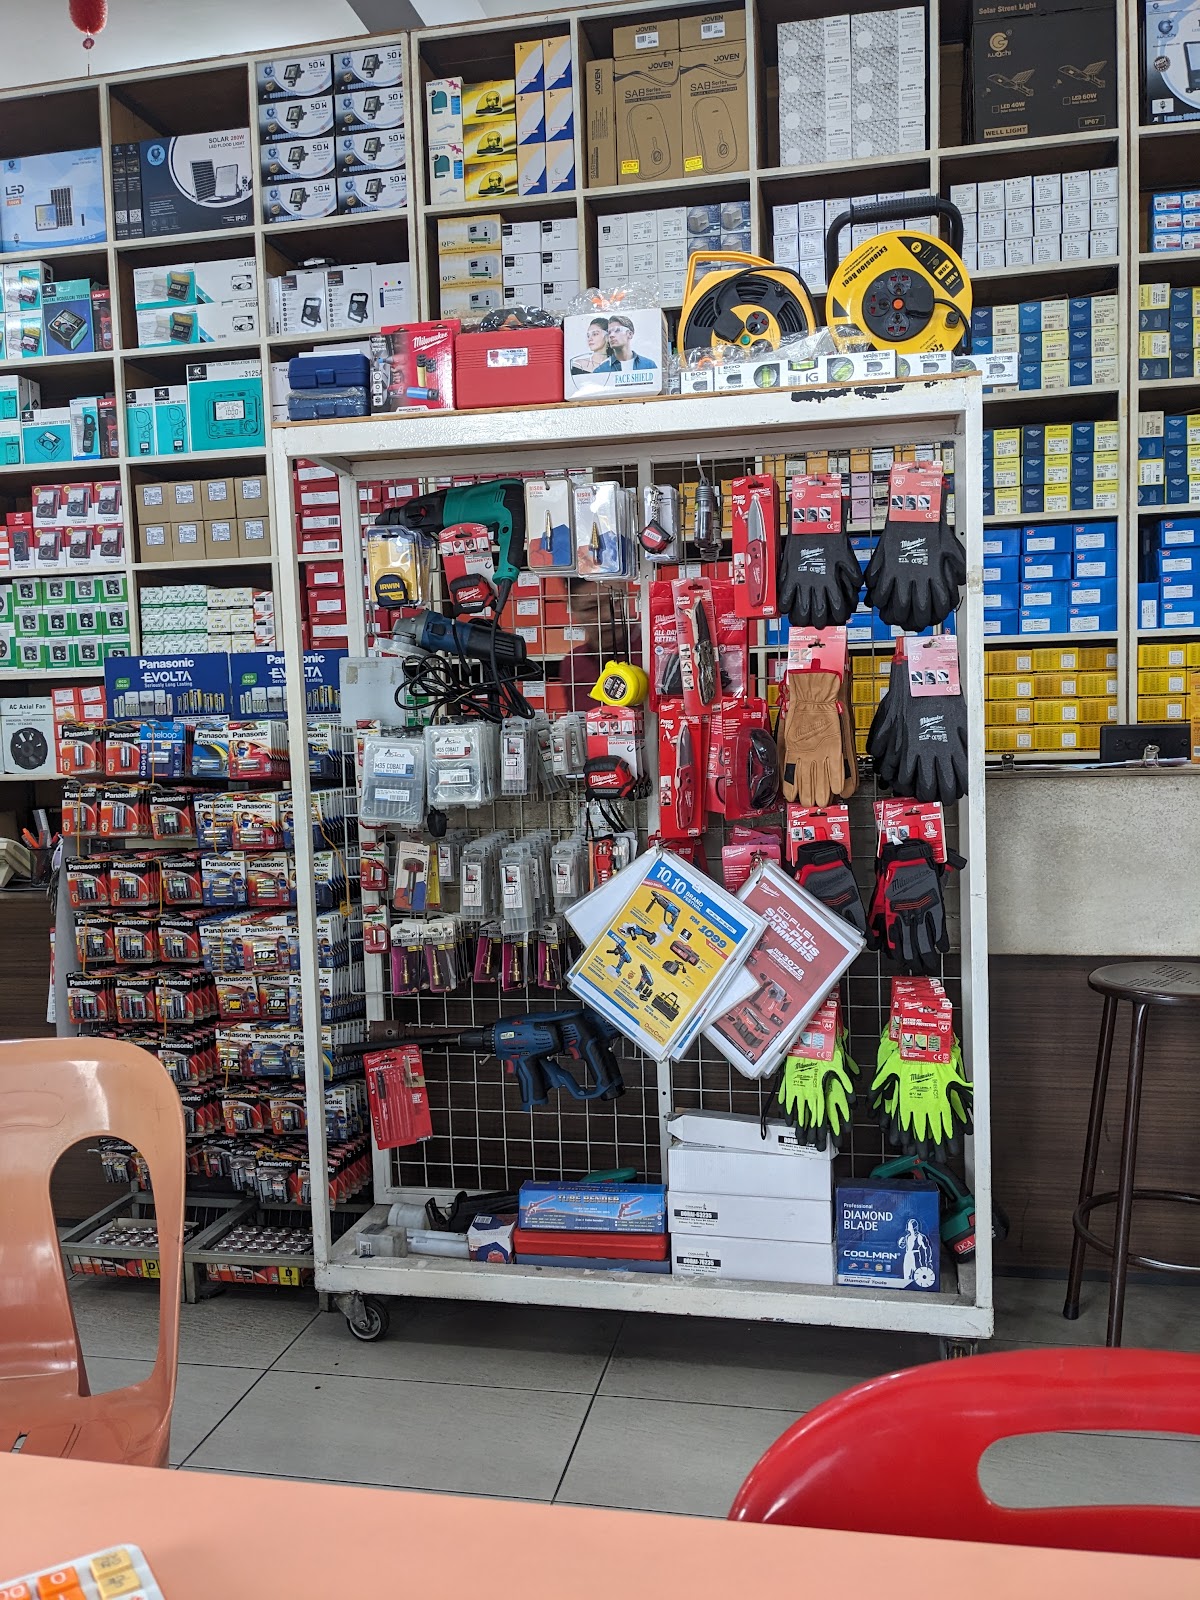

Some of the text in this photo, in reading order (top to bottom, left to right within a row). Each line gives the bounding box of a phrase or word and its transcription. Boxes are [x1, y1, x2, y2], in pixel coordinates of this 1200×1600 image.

[979, 7, 995, 15] Solar
[1019, 2, 1036, 11] Light
[702, 14, 723, 22] JOVEN
[714, 53, 739, 62] JOVEN
[648, 61, 673, 70] JOVEN
[1003, 127, 1026, 135] LIGHT
[5, 184, 24, 196] LED
[856, 246, 888, 273] Extension
[411, 332, 448, 348] Milwaukee
[615, 372, 653, 384] FACE SHIELD
[901, 538, 926, 548] Milwaukee
[379, 582, 400, 590] IRWIN
[139, 658, 195, 669] Panasonic
[141, 671, 192, 683] EVOLTA
[919, 715, 943, 725] Milwaukee
[590, 773, 617, 786] Milwaukee
[685, 892, 704, 907] BRAND
[689, 915, 727, 948] RM 1099
[765, 907, 820, 957] SDS-PLUS
[789, 917, 816, 945] FUEL
[611, 933, 622, 943] FREE
[795, 1062, 818, 1070] Milwaukee
[911, 1072, 934, 1081] Milwaukee
[258, 1160, 292, 1168] Panasonic
[558, 1195, 620, 1204] TUBE BENDER
[843, 1210, 893, 1221] DIAMOND
[844, 1221, 878, 1231] BLADE
[958, 1240, 973, 1251] DCA
[843, 1250, 897, 1259] COOLMAN
[148, 1262, 156, 1270] D
[285, 1269, 293, 1277] D
